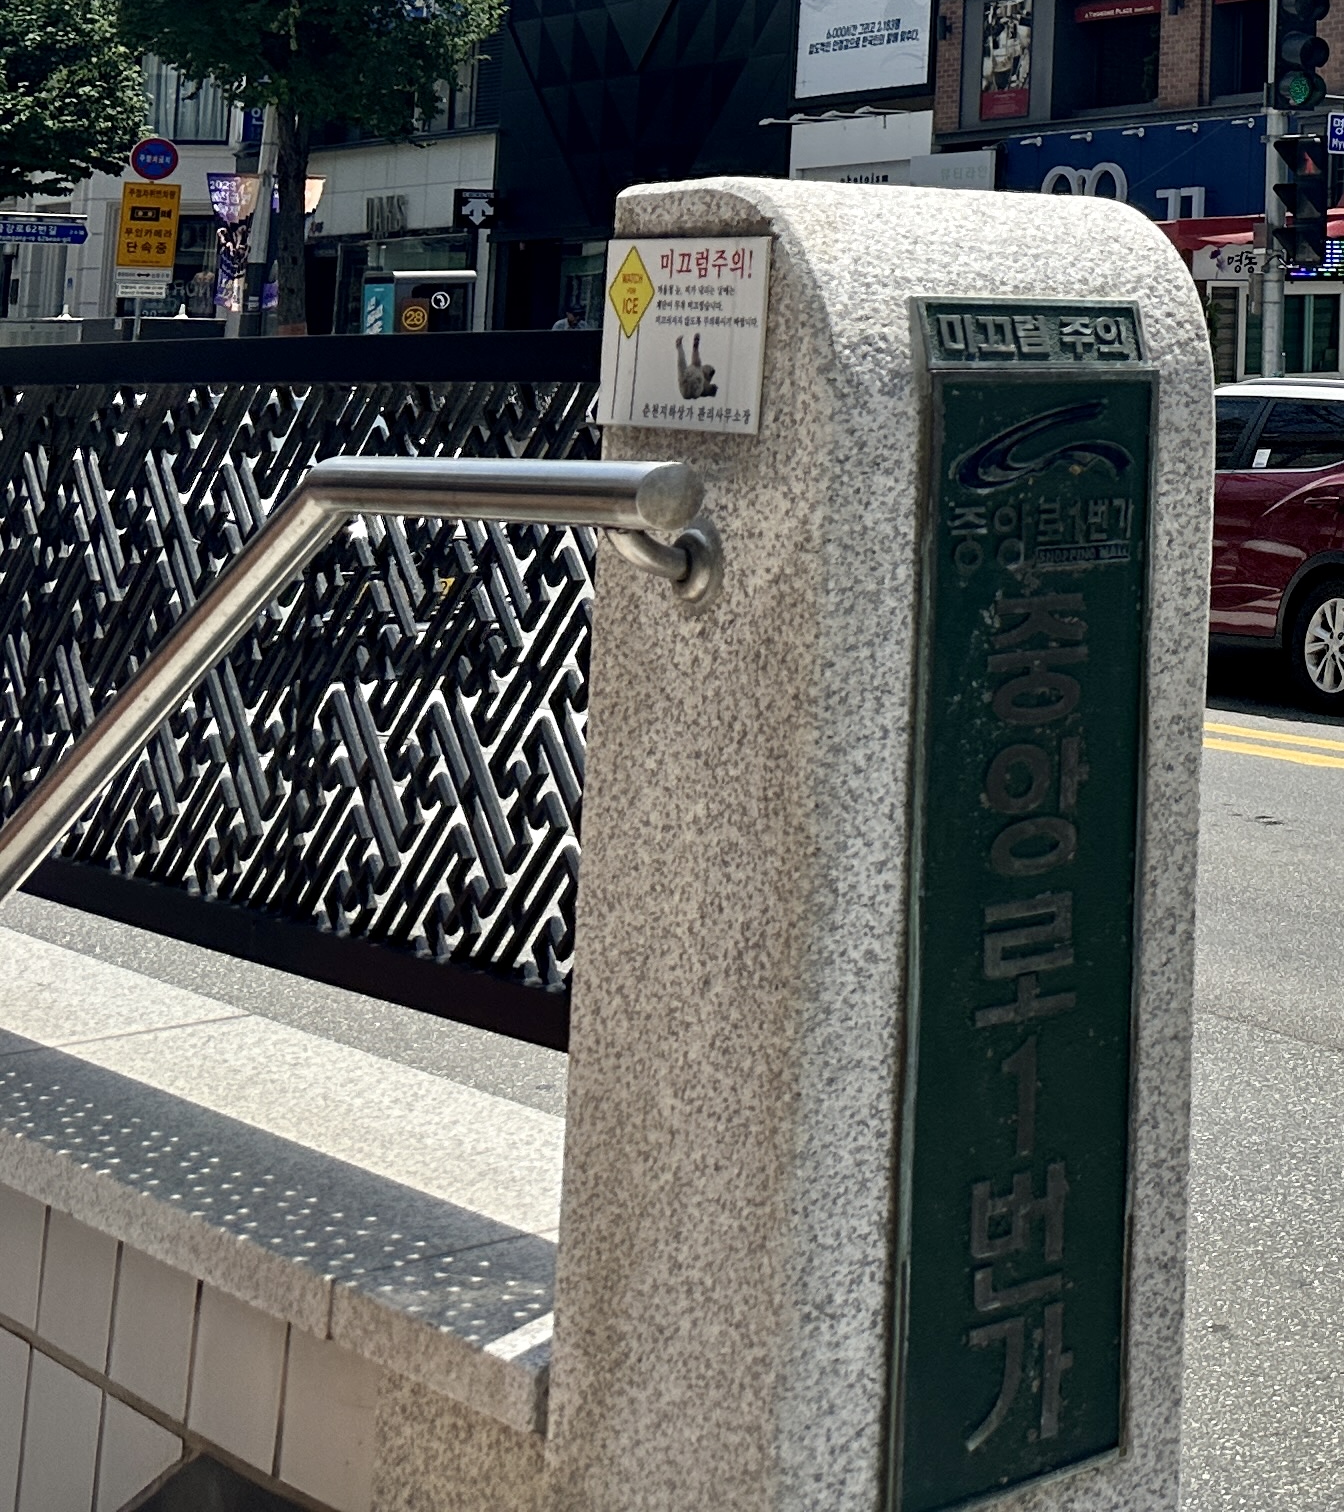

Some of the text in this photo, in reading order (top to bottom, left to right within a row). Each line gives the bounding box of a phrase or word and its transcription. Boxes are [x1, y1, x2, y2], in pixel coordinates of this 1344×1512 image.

[124, 228, 173, 239] 무인카메라
[126, 241, 168, 255] 단속중
[660, 247, 754, 279] 미끄럼주의!
[622, 298, 639, 315] ICE
[938, 314, 1130, 358] 미끄럼 주의
[965, 593, 1091, 1452] 중앙로1번가
